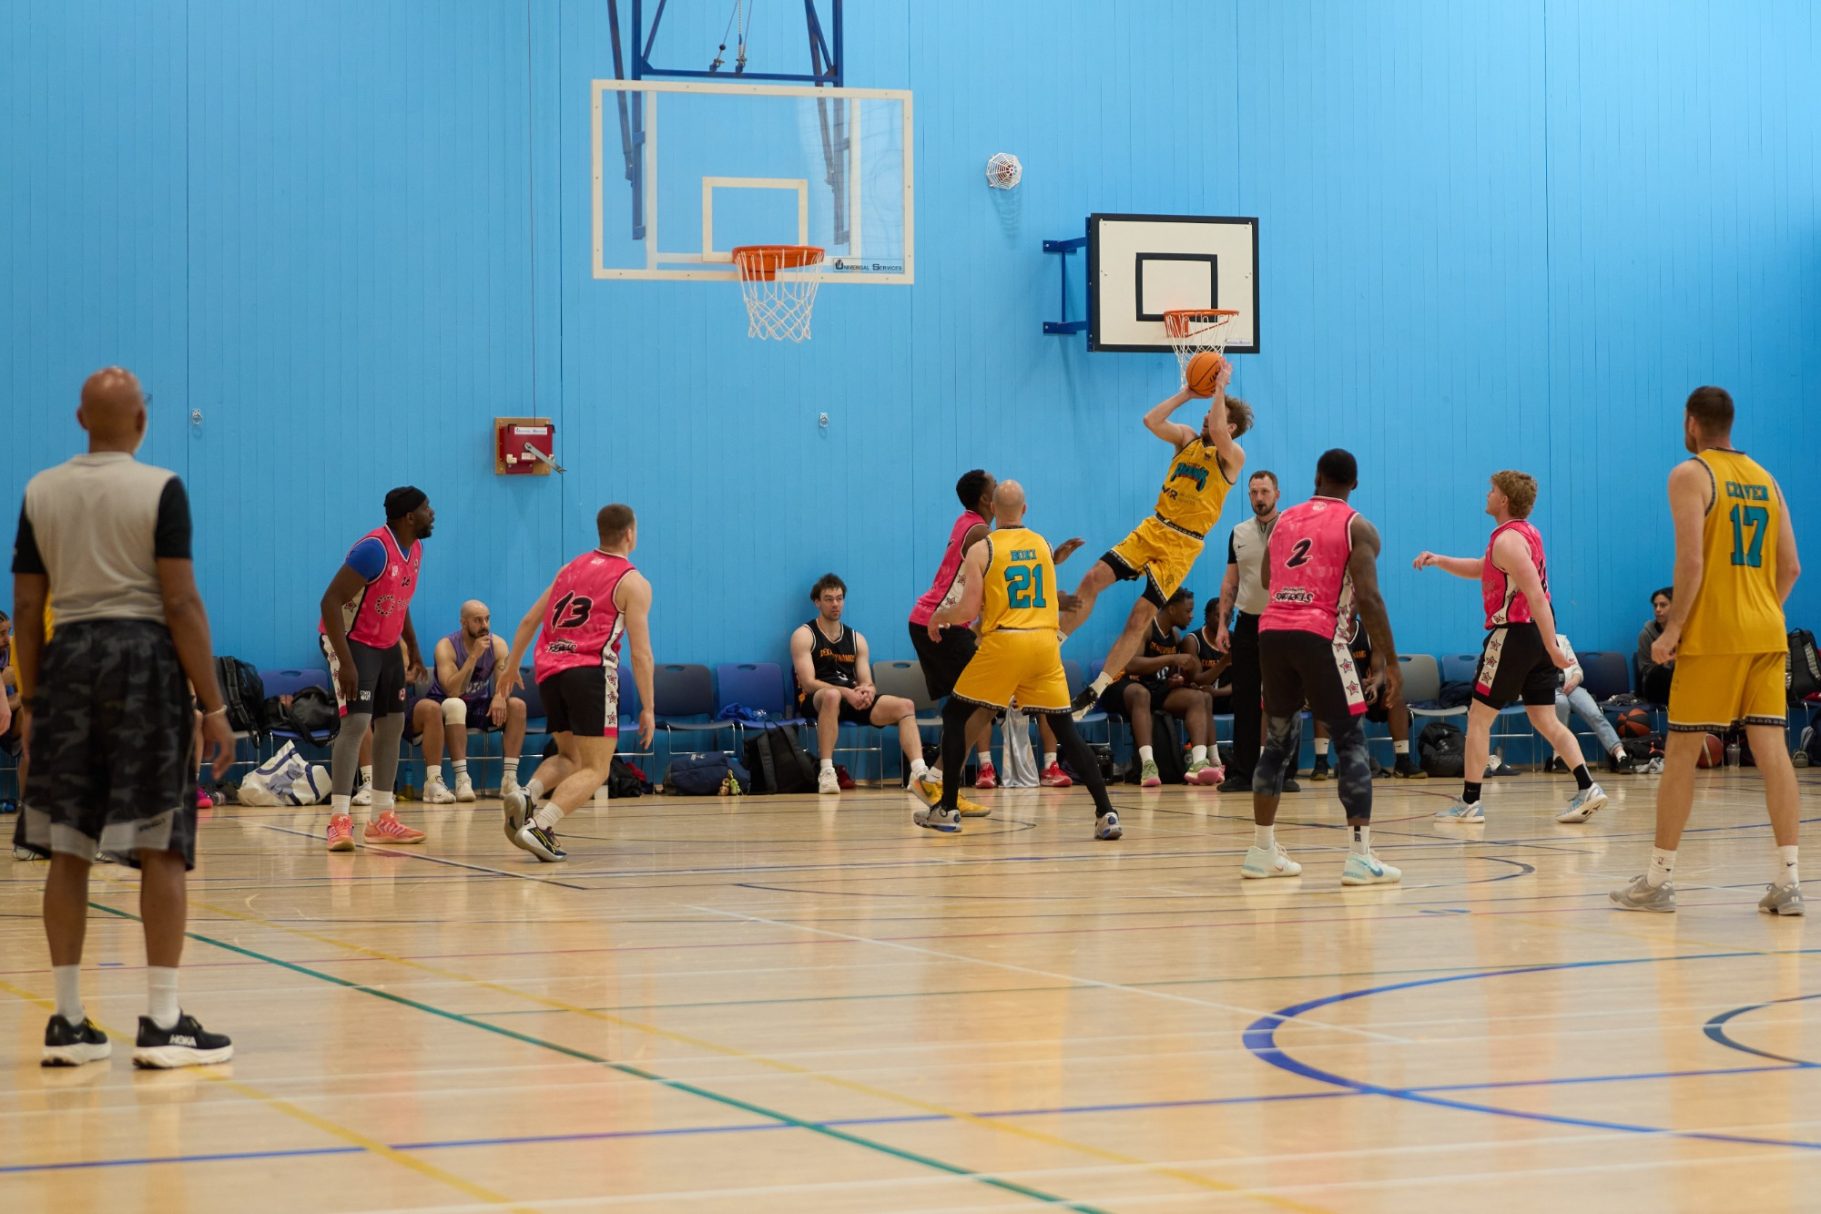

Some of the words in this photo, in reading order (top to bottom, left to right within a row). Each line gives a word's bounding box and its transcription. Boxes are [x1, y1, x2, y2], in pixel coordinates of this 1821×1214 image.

[1285, 538, 1313, 569] 2
[1730, 503, 1770, 568] 17
[1003, 563, 1047, 609] 21
[551, 590, 593, 632] 13
[168, 1034, 197, 1047] HOKA
